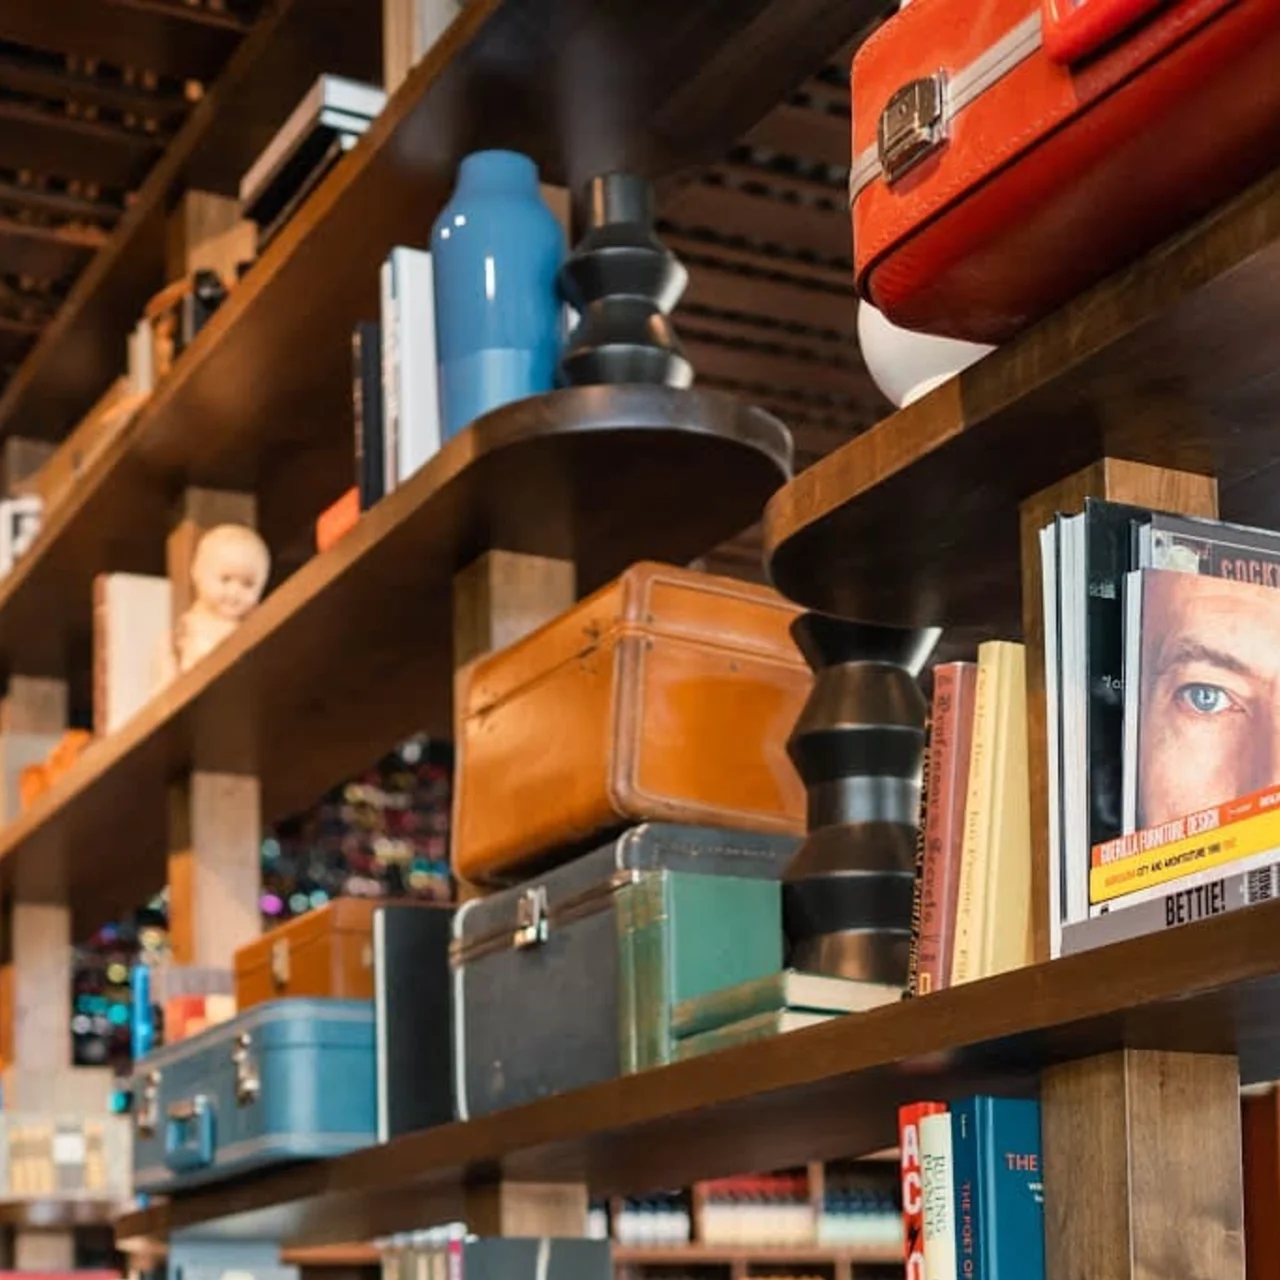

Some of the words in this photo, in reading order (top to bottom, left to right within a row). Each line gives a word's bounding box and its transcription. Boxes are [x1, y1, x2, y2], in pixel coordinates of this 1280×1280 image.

[1166, 879, 1226, 926] BETTIE!
[1005, 1153, 1039, 1172] THE
[962, 1183, 972, 1207] THE
[963, 1259, 974, 1279] OF
